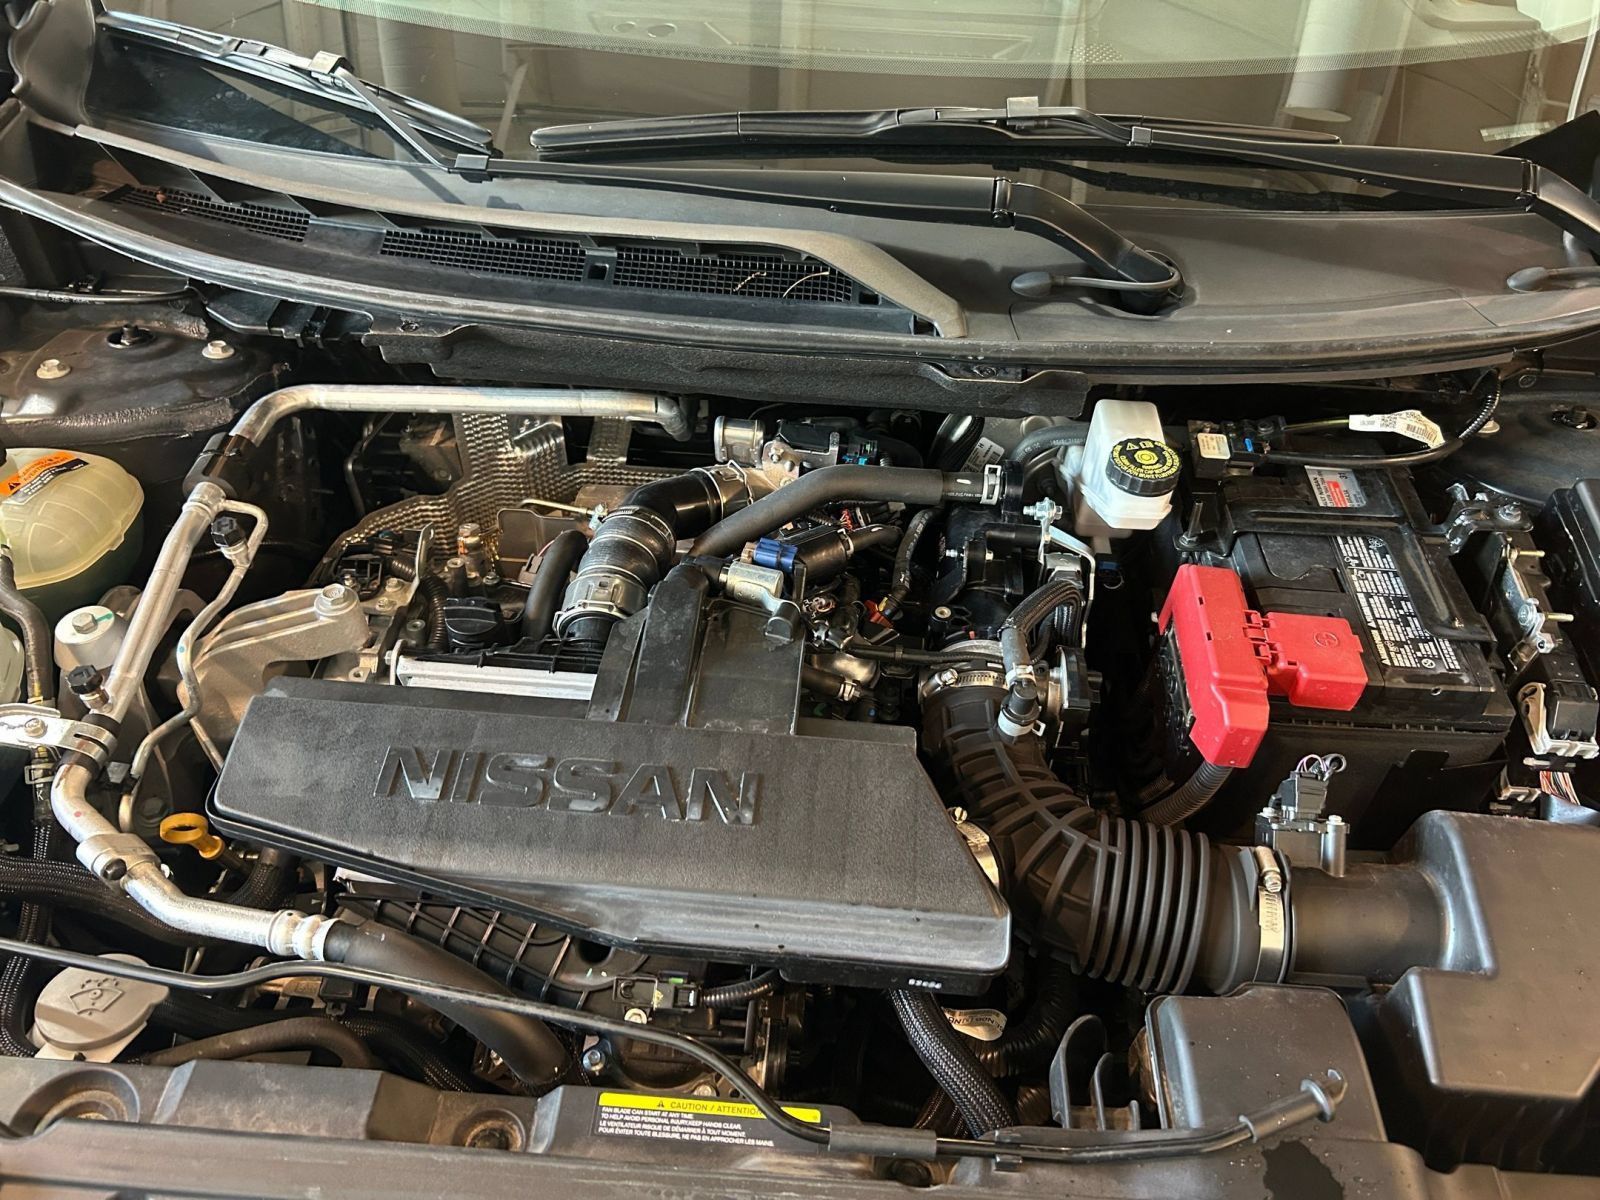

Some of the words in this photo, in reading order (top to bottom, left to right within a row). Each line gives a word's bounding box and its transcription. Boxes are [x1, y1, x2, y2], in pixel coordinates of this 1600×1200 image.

[373, 744, 762, 826] NISSAN
[670, 1101, 708, 1111] CAUTION
[641, 1116, 669, 1124] PERSONAL
[707, 1128, 720, 1136] TOUT
[710, 1136, 744, 1145] APPROCHER
